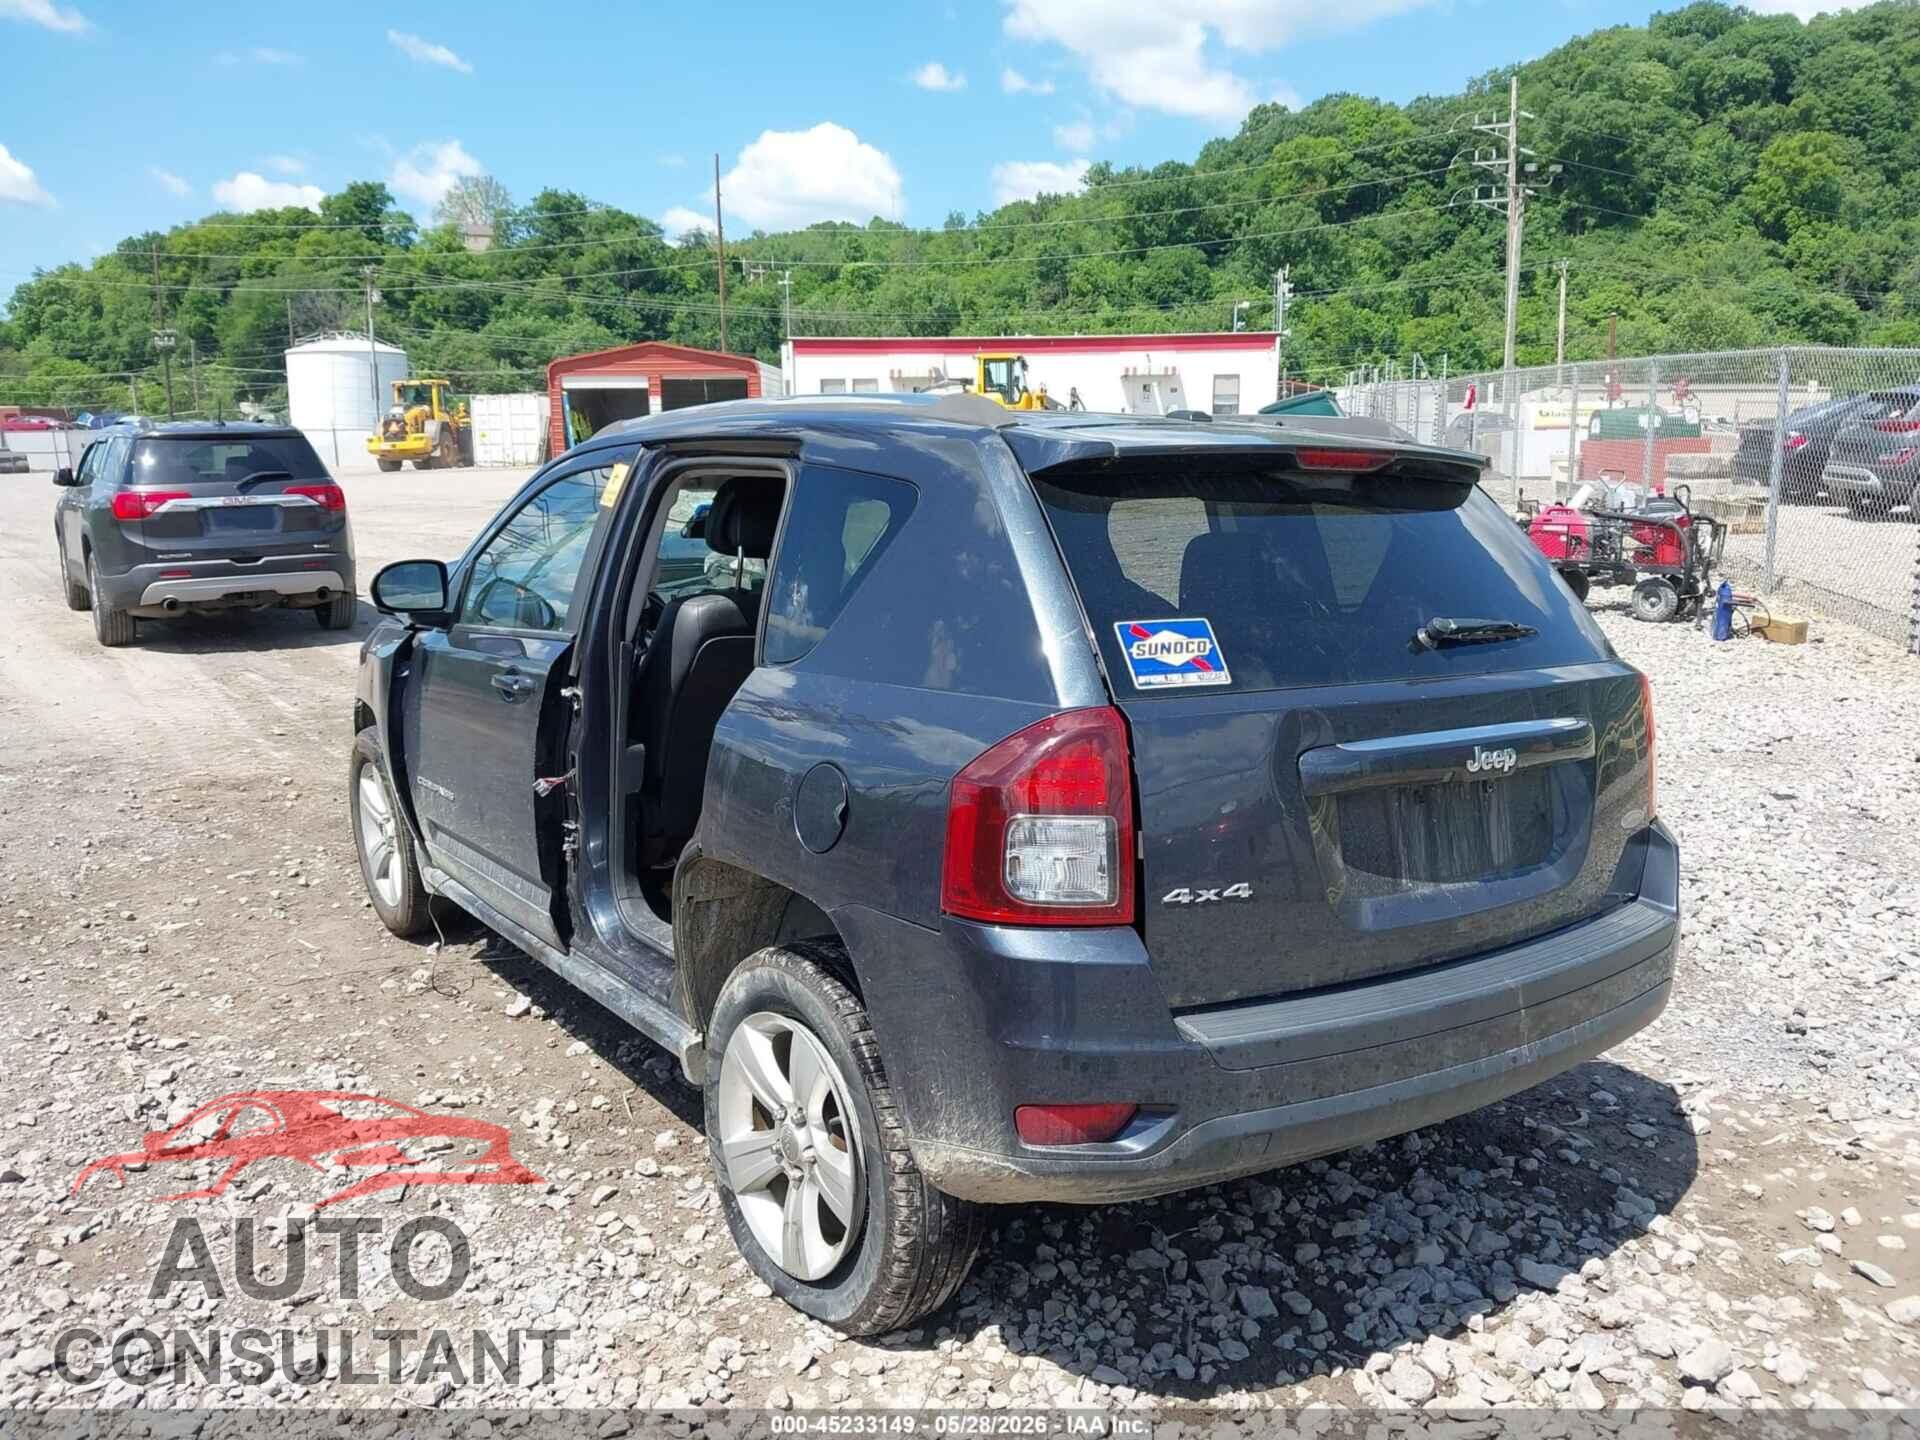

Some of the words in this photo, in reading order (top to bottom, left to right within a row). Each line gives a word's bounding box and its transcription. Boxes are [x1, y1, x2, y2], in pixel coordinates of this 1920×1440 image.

[1136, 640, 1207, 657] SUNOCO
[1466, 745, 1517, 773] Jeep
[1162, 882, 1253, 904] 4x4
